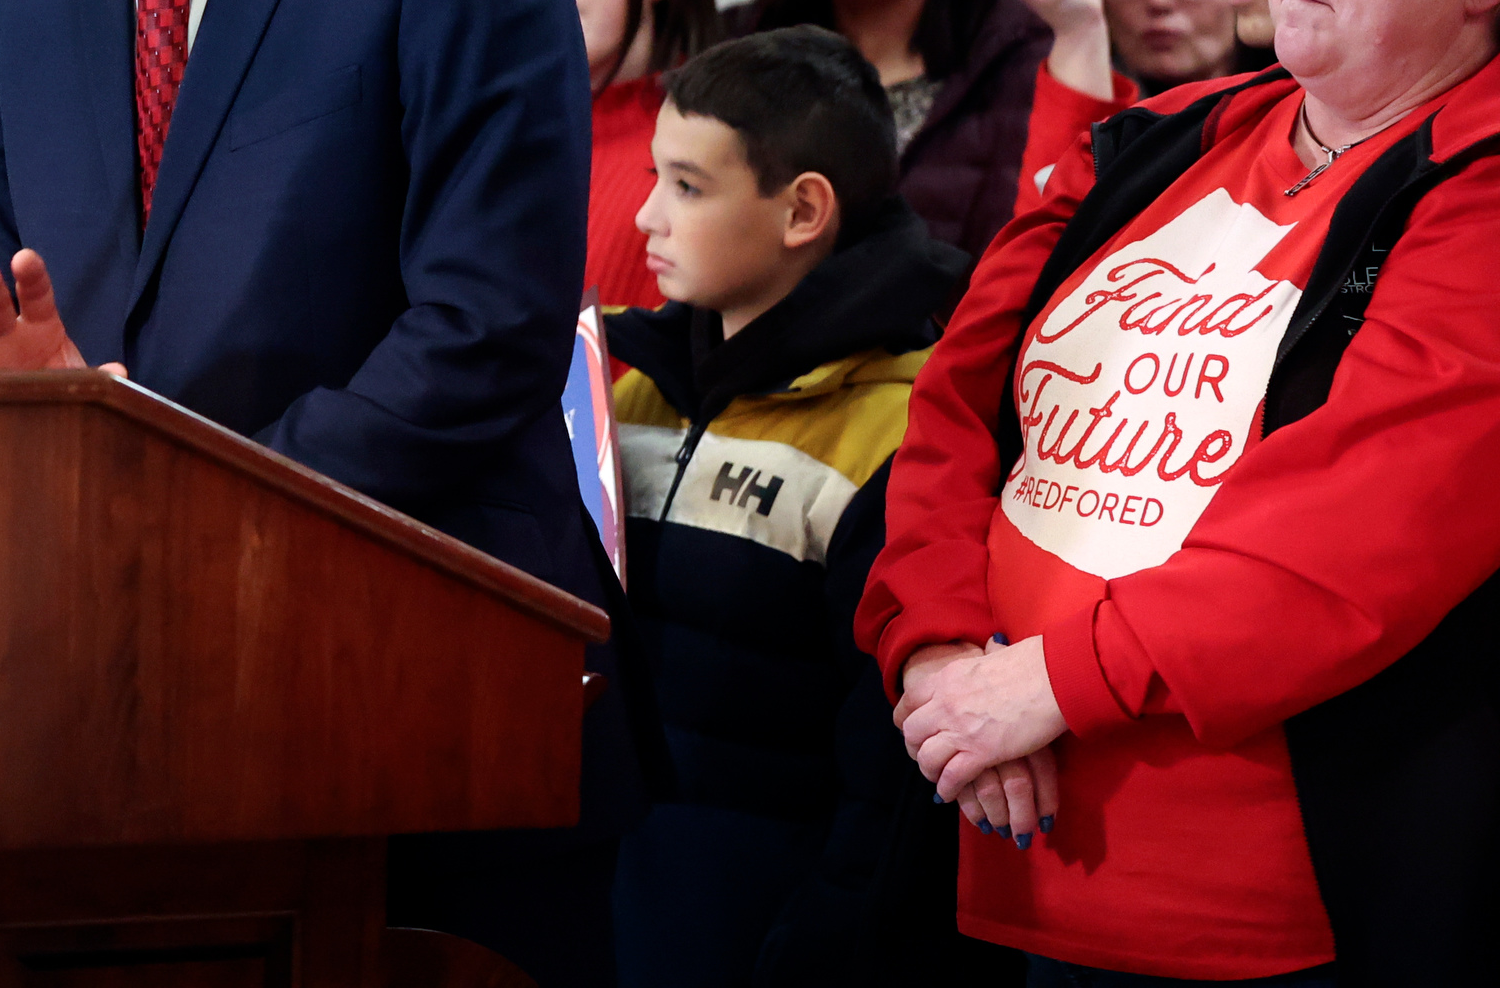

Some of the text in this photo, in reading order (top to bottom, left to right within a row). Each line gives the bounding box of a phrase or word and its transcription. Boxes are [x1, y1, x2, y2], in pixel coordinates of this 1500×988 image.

[1035, 257, 1280, 344] Fund
[1124, 352, 1230, 403] OUR
[1007, 359, 1236, 487] Future
[1013, 475, 1165, 527] #REDFORED
